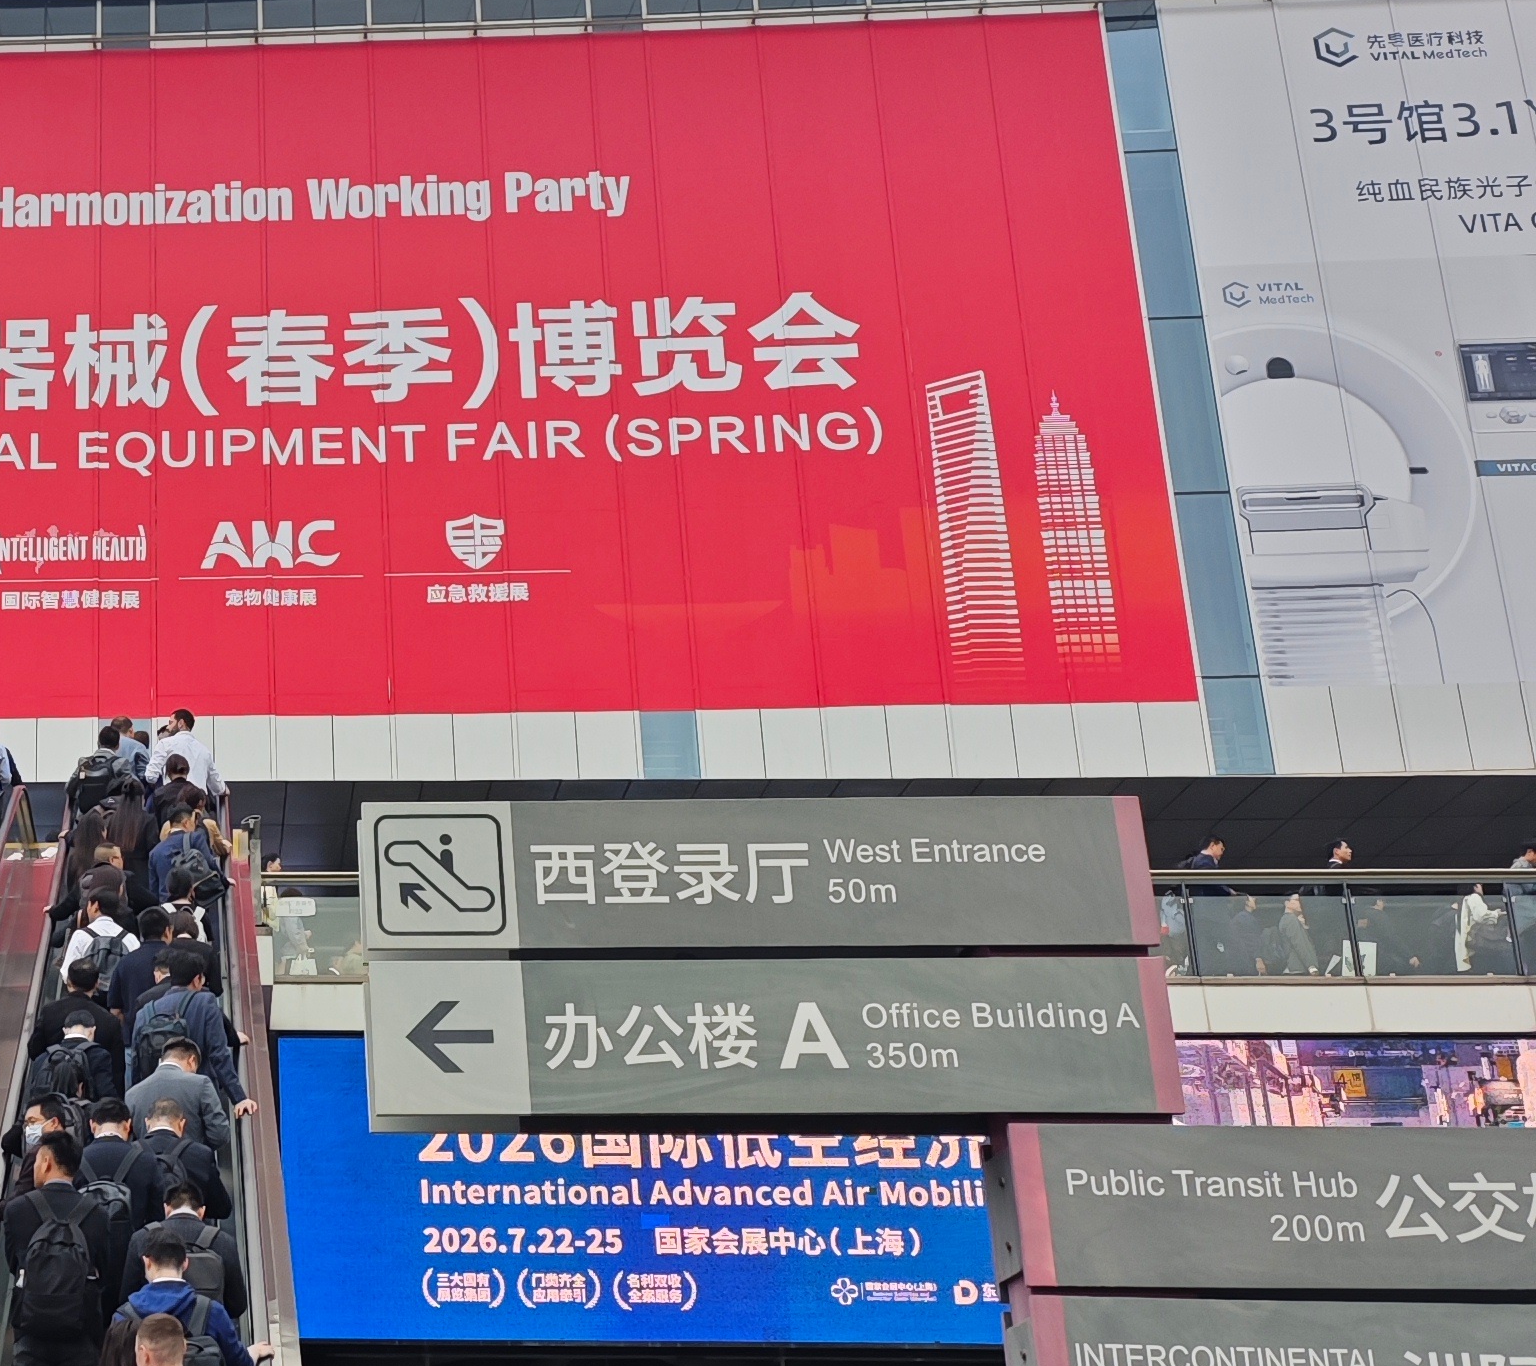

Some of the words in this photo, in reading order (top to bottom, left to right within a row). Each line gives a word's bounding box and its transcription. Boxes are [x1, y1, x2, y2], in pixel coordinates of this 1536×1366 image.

[1370, 47, 1420, 61] VITAL
[1423, 47, 1487, 59] MedTech
[1310, 100, 1536, 145] 3号馆3.1
[306, 175, 491, 221] Working
[505, 171, 630, 217] Party
[1458, 213, 1523, 233] VITA
[1257, 282, 1303, 291] VITAL
[1259, 294, 1314, 304] MedTech
[79, 425, 425, 476] EQUIPMENT
[447, 421, 585, 461] FAIR
[606, 407, 882, 462] (SPRING)
[93, 525, 146, 561] HEALTH
[2, 589, 139, 609] 国际智慧健康展
[226, 589, 316, 606] 宠物健康展
[427, 582, 529, 603] 应急救援展
[823, 839, 901, 863] West
[911, 839, 1045, 862] Entrance
[530, 841, 809, 904] 西登录厅
[829, 879, 896, 903] 50m
[862, 1003, 960, 1028] Office
[972, 1003, 1107, 1034] Building
[1117, 1003, 1140, 1028] A
[545, 1003, 757, 1069] 办公楼
[780, 1002, 849, 1069] A
[867, 1043, 958, 1068] 350m
[421, 1178, 641, 1205] International
[650, 1179, 812, 1206] Advanced
[823, 1179, 870, 1205] Air
[1066, 1169, 1165, 1196] Public
[1172, 1170, 1283, 1197] Transit
[1292, 1171, 1357, 1197] Hub
[1376, 1172, 1536, 1243] 公交
[423, 1228, 622, 1254] 2026.7.22-25
[1270, 1215, 1365, 1241] 200m
